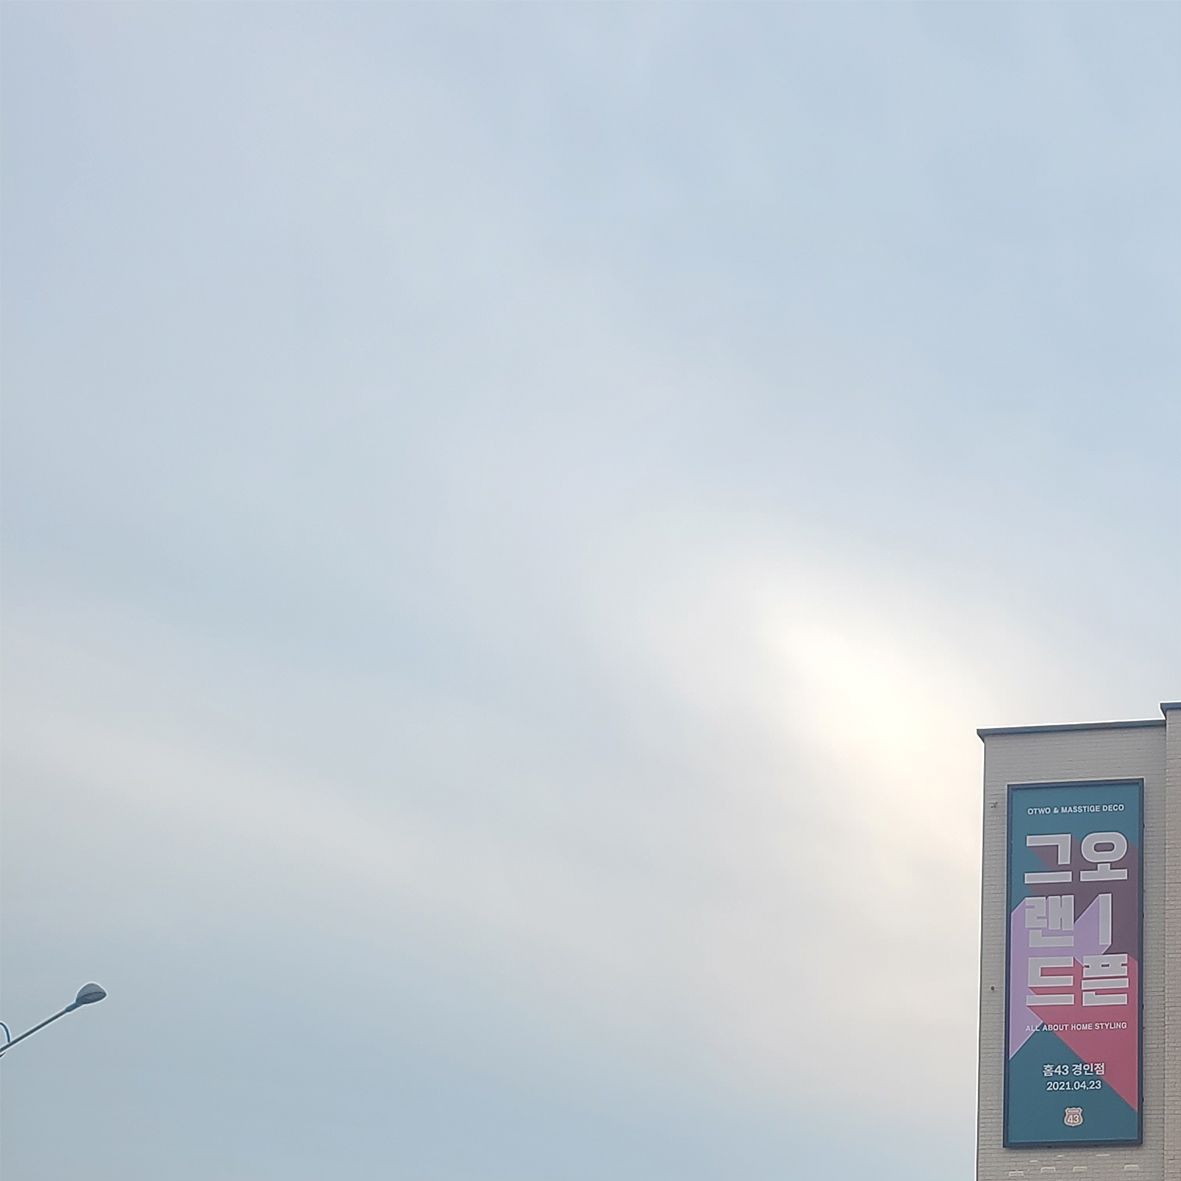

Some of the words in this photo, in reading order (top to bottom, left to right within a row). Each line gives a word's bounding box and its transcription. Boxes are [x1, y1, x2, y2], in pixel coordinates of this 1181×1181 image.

[1027, 807, 1051, 815] OTWO
[1053, 806, 1059, 814] &
[1061, 804, 1100, 813] MASSTIGE
[1102, 803, 1125, 812] DECO
[1025, 1024, 1041, 1032] ALL
[1042, 1023, 1069, 1032] ABOUT
[1070, 1022, 1093, 1031] HOME
[1094, 1021, 1127, 1030] STYLING
[1071, 1062, 1105, 1076] 경인점
[1046, 1080, 1102, 1091] 2021.04.23
[1067, 1114, 1080, 1124] 43
